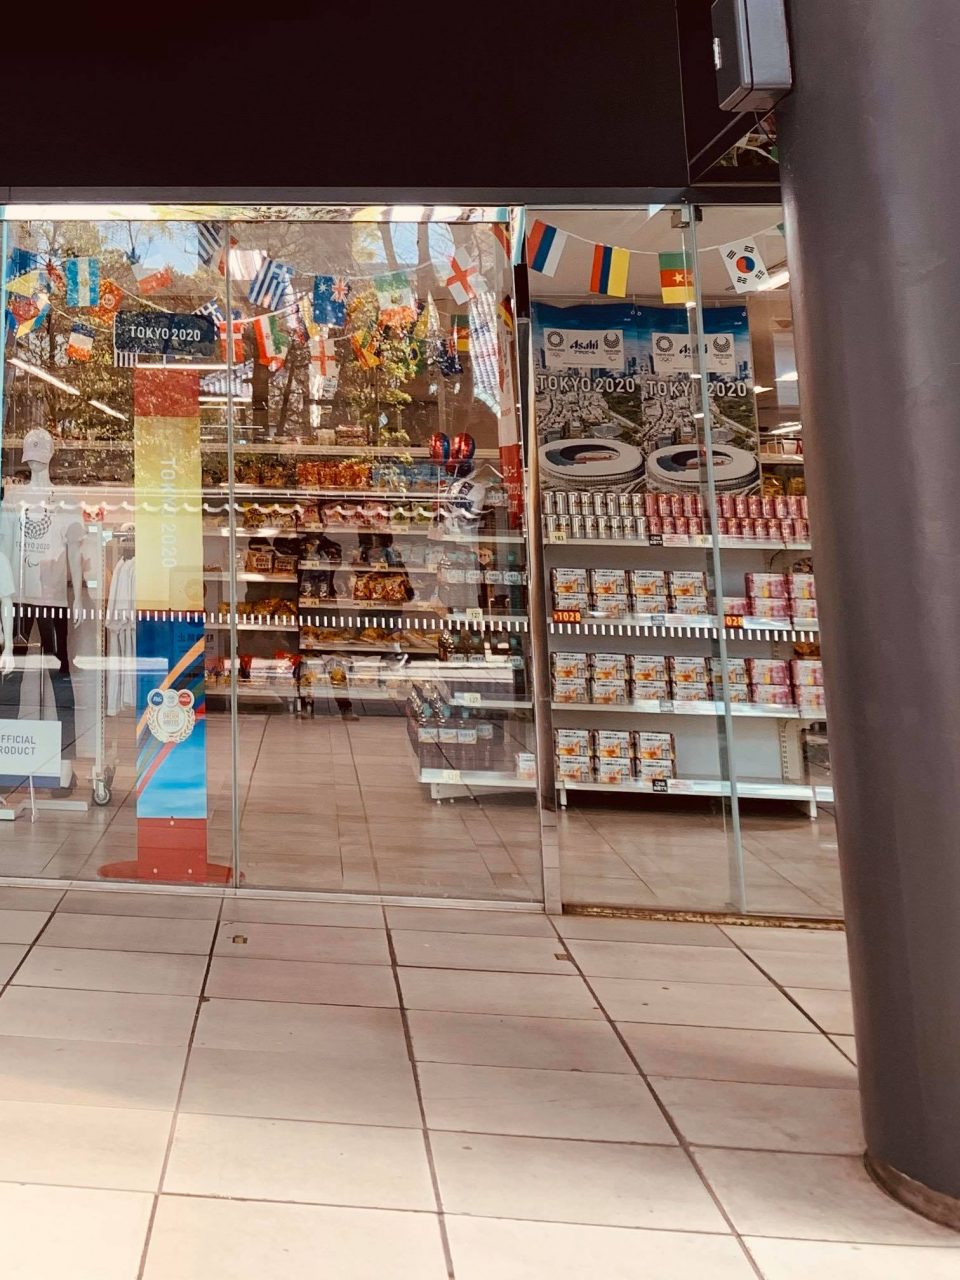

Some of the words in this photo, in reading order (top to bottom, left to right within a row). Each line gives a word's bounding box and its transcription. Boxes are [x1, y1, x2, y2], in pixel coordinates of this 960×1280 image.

[129, 326, 169, 340] TOKYO
[171, 328, 201, 342] 2020
[569, 339, 599, 350] Asahi
[537, 374, 590, 393] TOKYO
[595, 377, 636, 394] 2020
[707, 381, 748, 398] 2020
[160, 523, 177, 568] 2020
